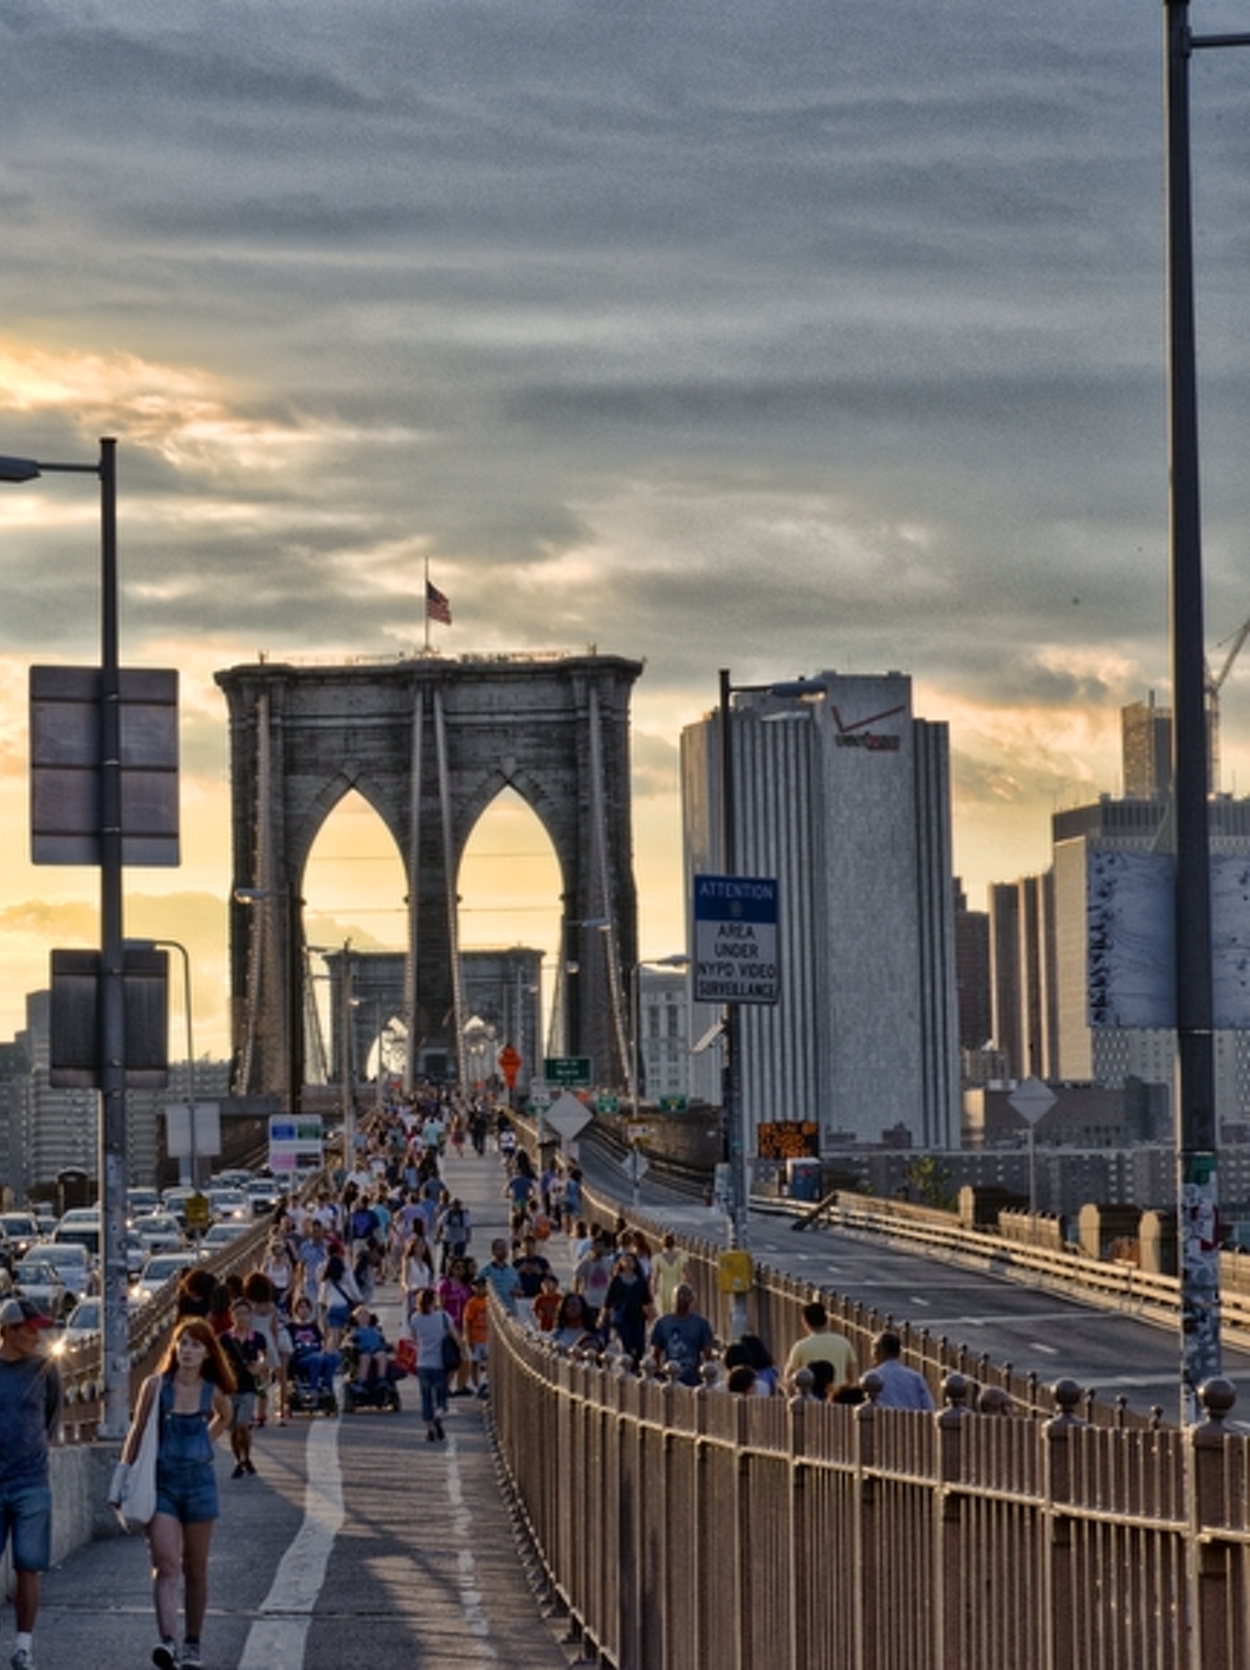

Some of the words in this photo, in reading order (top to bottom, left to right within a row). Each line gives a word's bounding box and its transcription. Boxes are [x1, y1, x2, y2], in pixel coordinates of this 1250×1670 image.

[699, 882, 773, 899] ATTENTION
[717, 924, 755, 938] AREA
[714, 943, 759, 958] UNDER
[698, 960, 735, 977] NYPD
[740, 963, 776, 979] VIDEO
[699, 981, 775, 998] SURVEILLANCE
